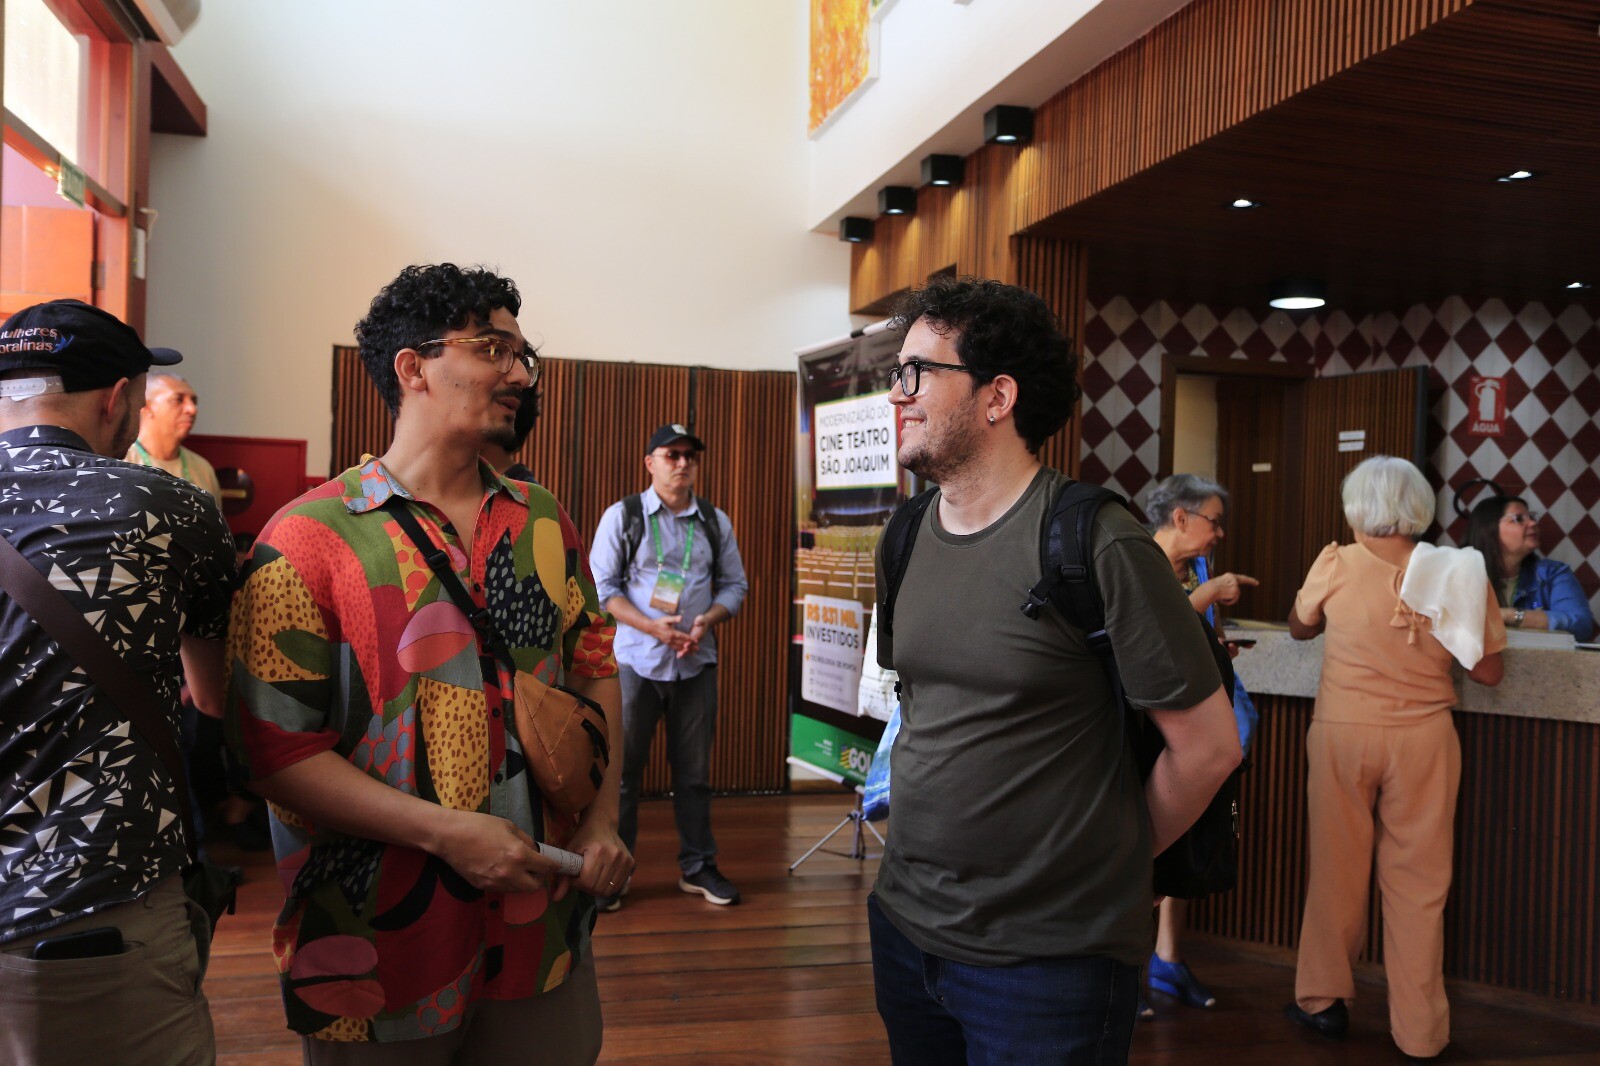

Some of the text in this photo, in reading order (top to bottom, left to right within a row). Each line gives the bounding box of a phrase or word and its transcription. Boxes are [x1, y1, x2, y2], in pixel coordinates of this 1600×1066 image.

[877, 405, 889, 419] DO
[819, 427, 890, 452] CINE TEATRO
[821, 454, 890, 475] SÃO JOAQUIM
[806, 625, 859, 649] INVESTIDOS
